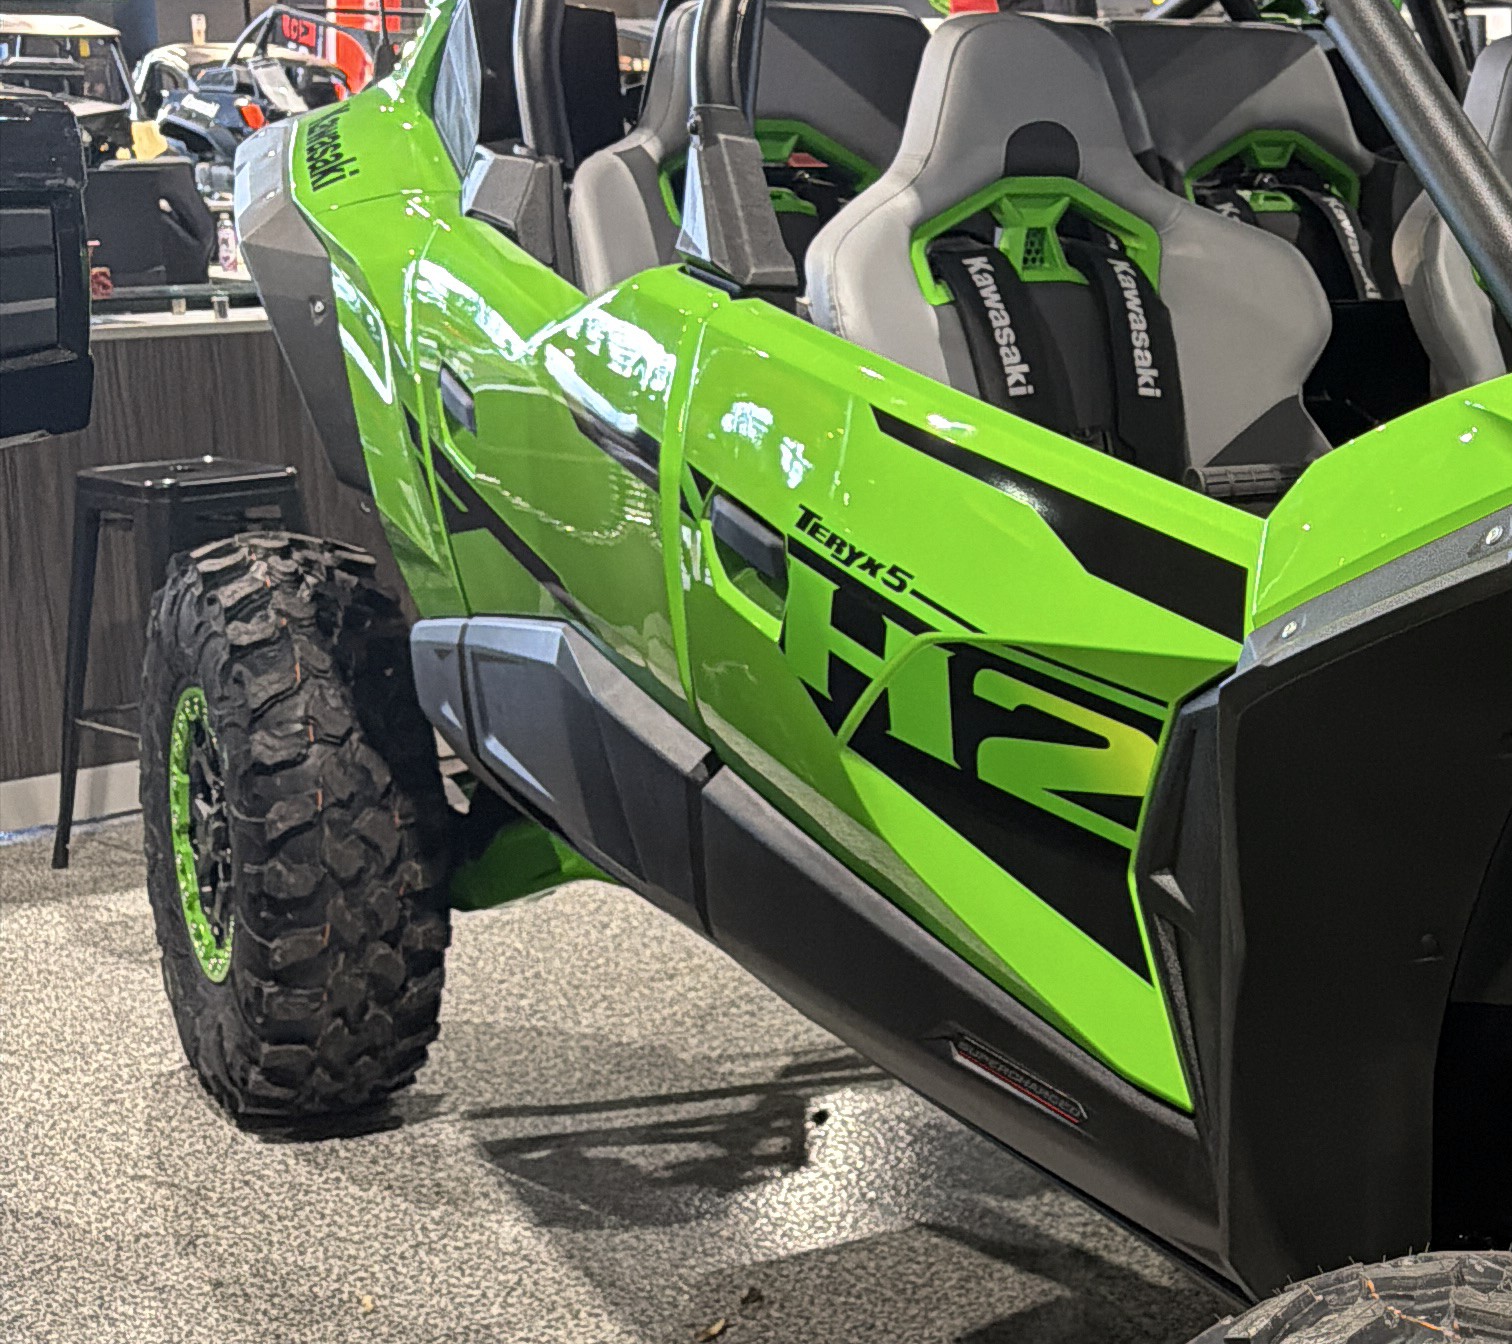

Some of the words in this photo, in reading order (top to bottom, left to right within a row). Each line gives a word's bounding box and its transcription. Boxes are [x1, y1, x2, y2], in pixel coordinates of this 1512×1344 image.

[961, 255, 1035, 397] Kawasaki
[1106, 257, 1162, 398] Kawasaki
[781, 554, 1161, 852] H2
